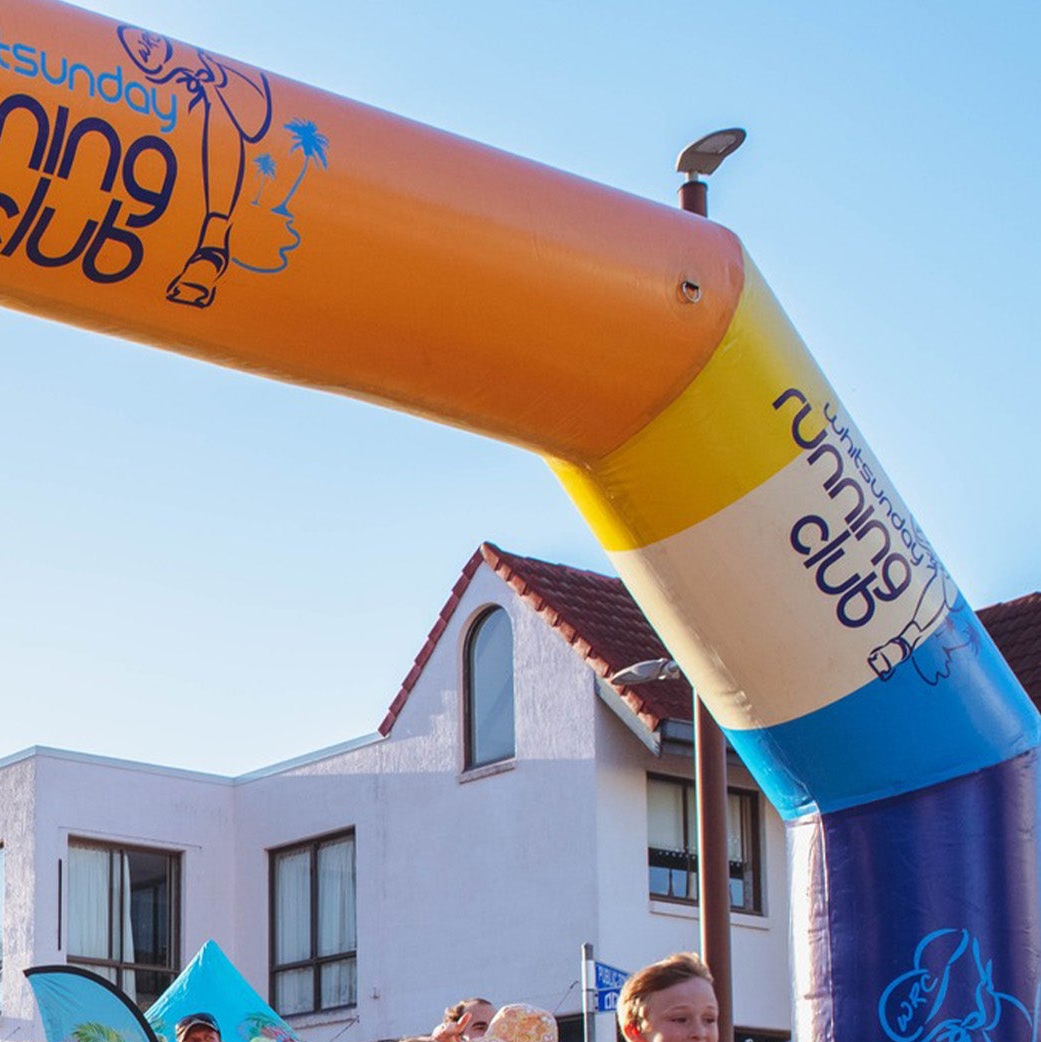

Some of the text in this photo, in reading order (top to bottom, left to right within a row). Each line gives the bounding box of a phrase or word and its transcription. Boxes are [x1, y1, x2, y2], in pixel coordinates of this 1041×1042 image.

[772, 388, 912, 602] running
[824, 402, 925, 567] whitsunday
[790, 514, 876, 628] club
